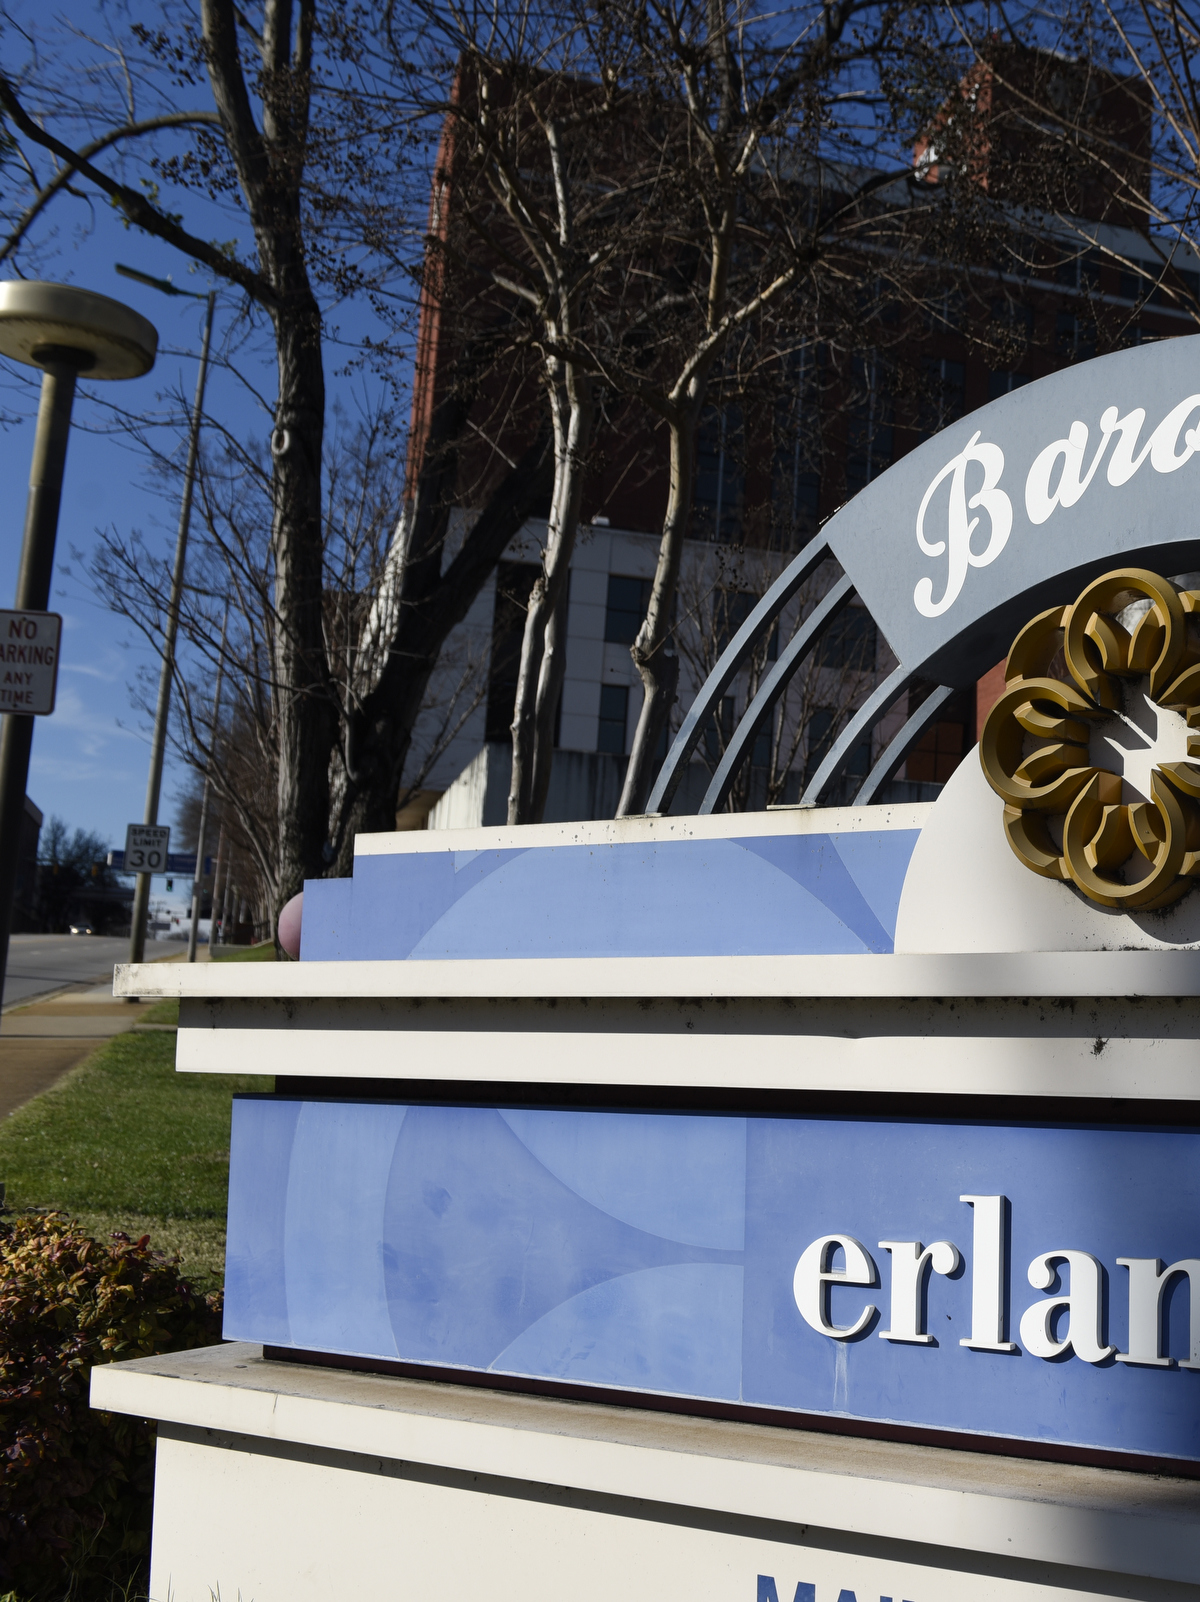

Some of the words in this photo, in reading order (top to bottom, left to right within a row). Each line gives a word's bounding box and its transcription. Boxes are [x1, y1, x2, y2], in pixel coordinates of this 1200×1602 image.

[8, 619, 37, 639] NO
[0, 643, 54, 666] ARKING
[3, 671, 33, 685] ANY
[0, 689, 34, 704] TIME
[131, 828, 167, 838] SPEED
[133, 838, 162, 847] LIMIT
[129, 849, 161, 869] 30
